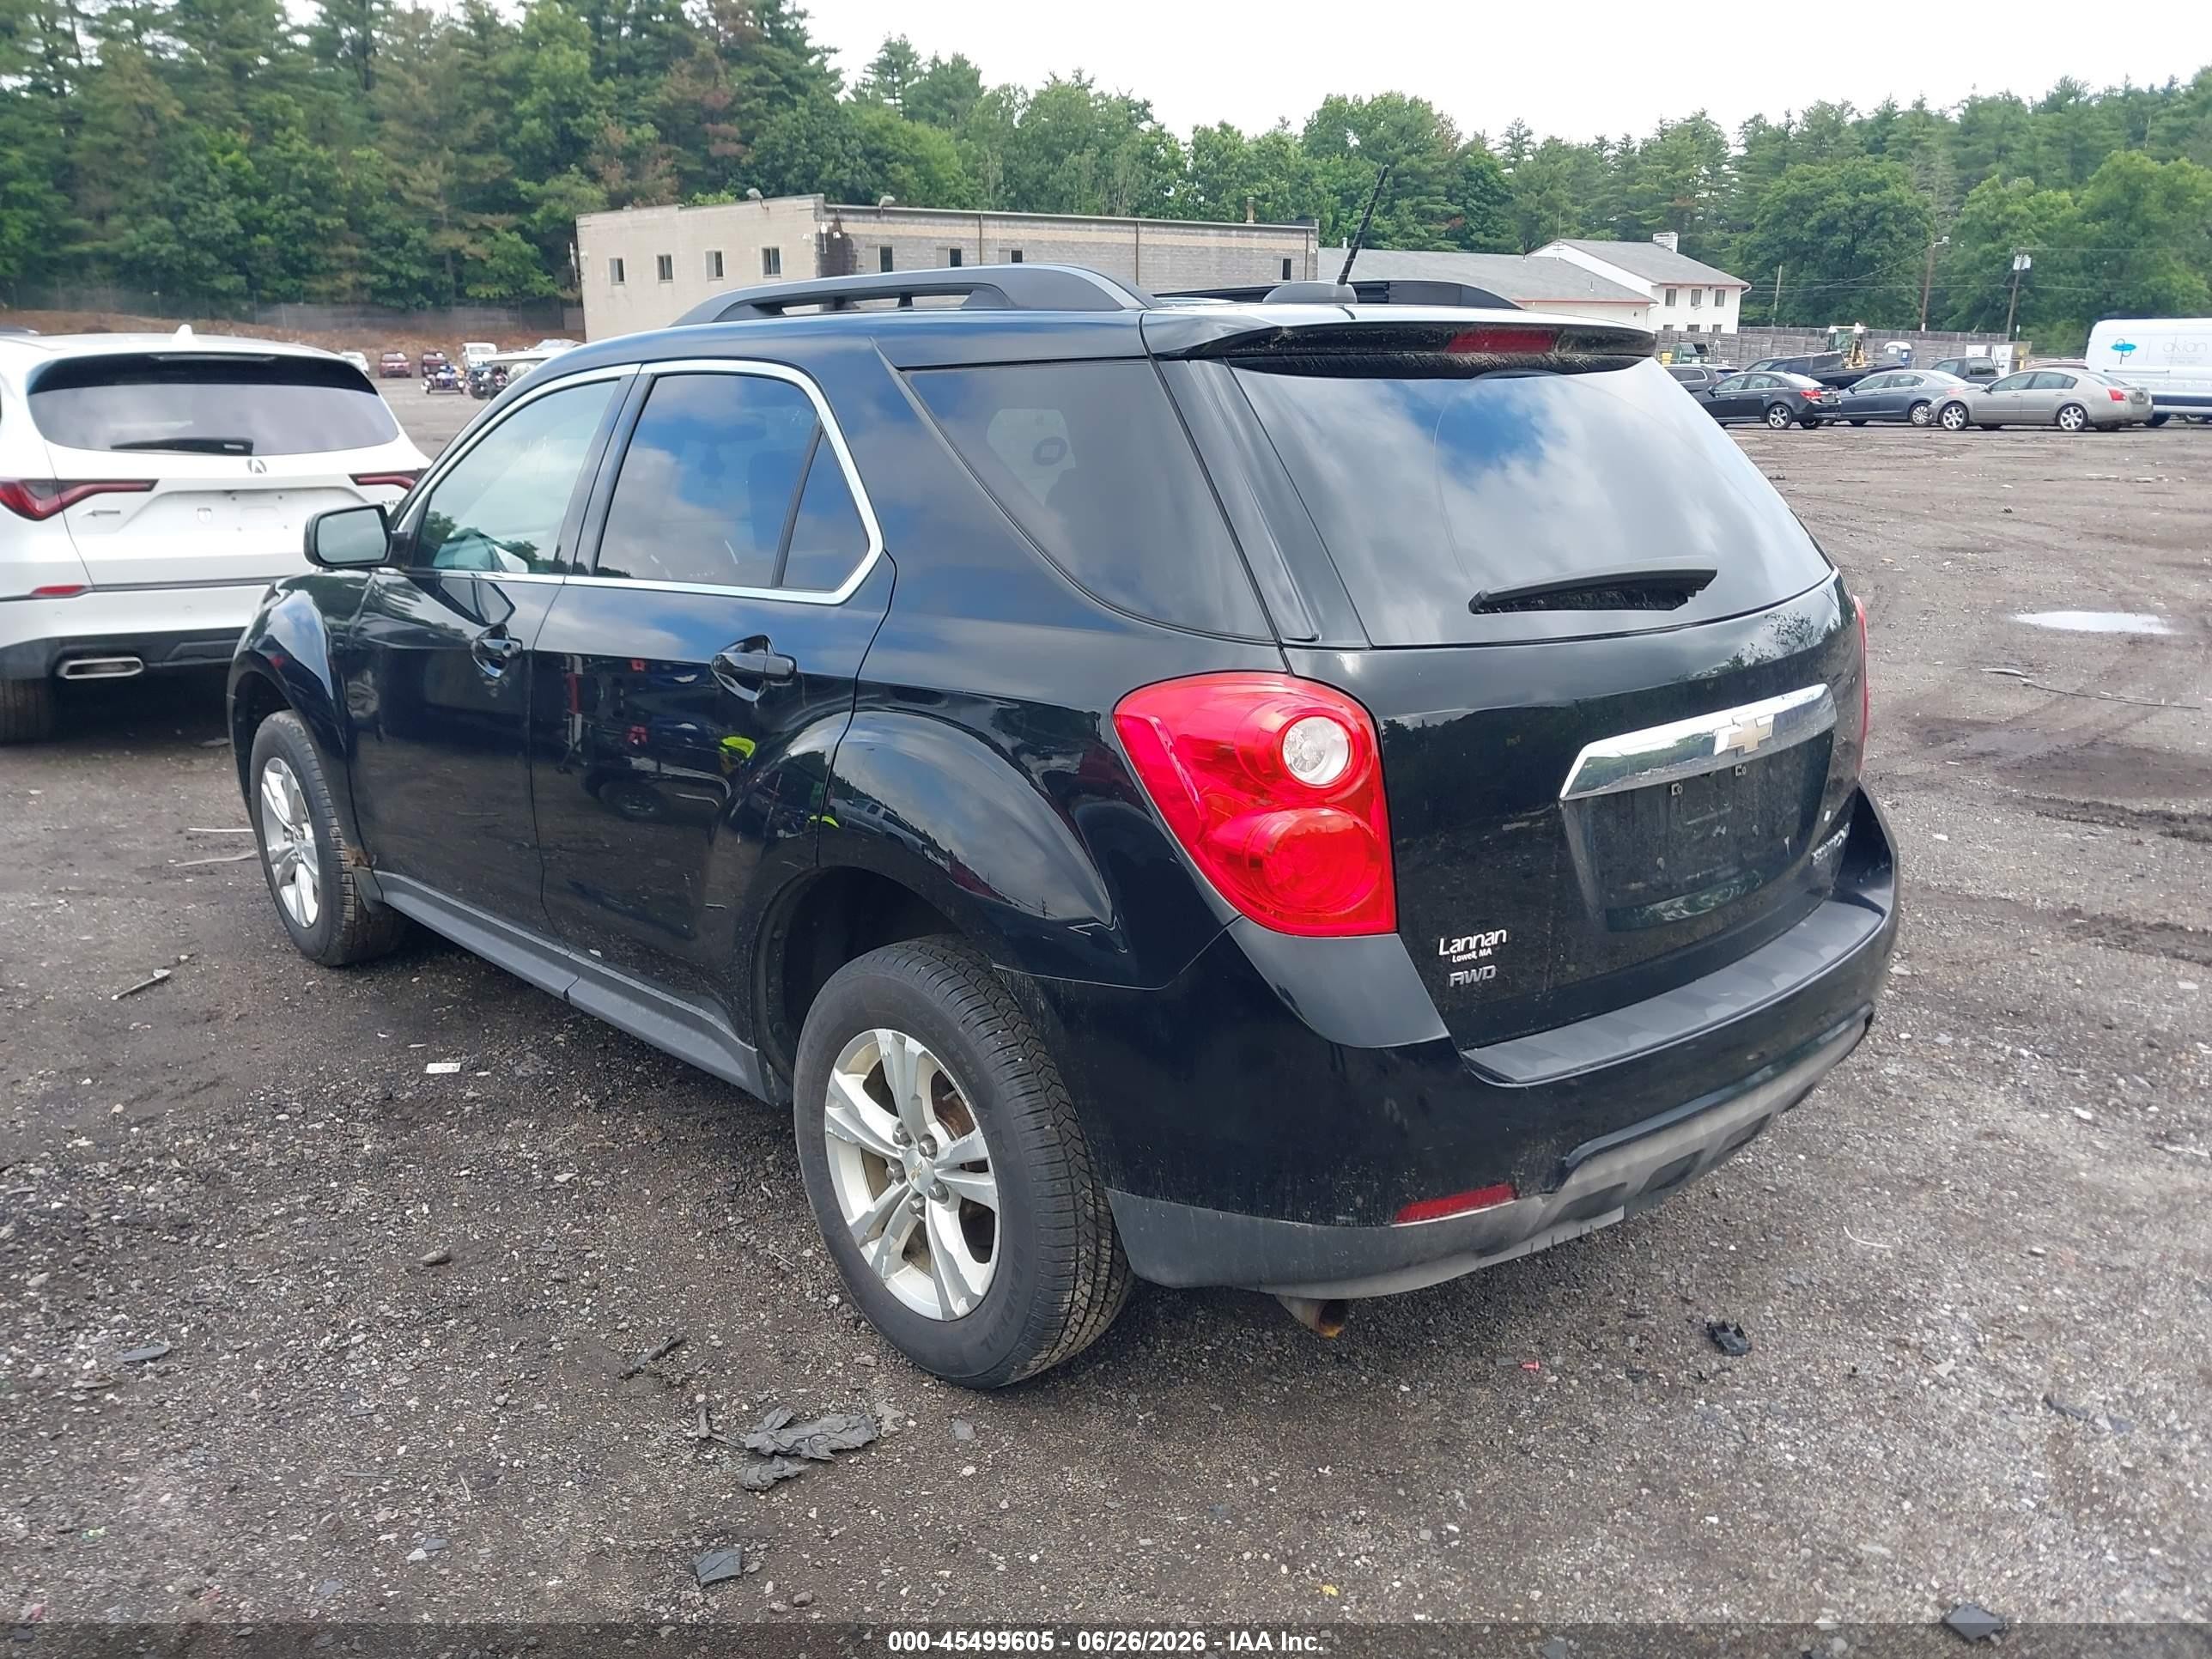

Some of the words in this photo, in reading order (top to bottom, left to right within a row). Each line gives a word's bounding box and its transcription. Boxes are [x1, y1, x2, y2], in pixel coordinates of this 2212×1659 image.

[1438, 929, 1508, 956] Lannan
[1478, 947, 1492, 958] MA
[1449, 964, 1497, 988] AWD
